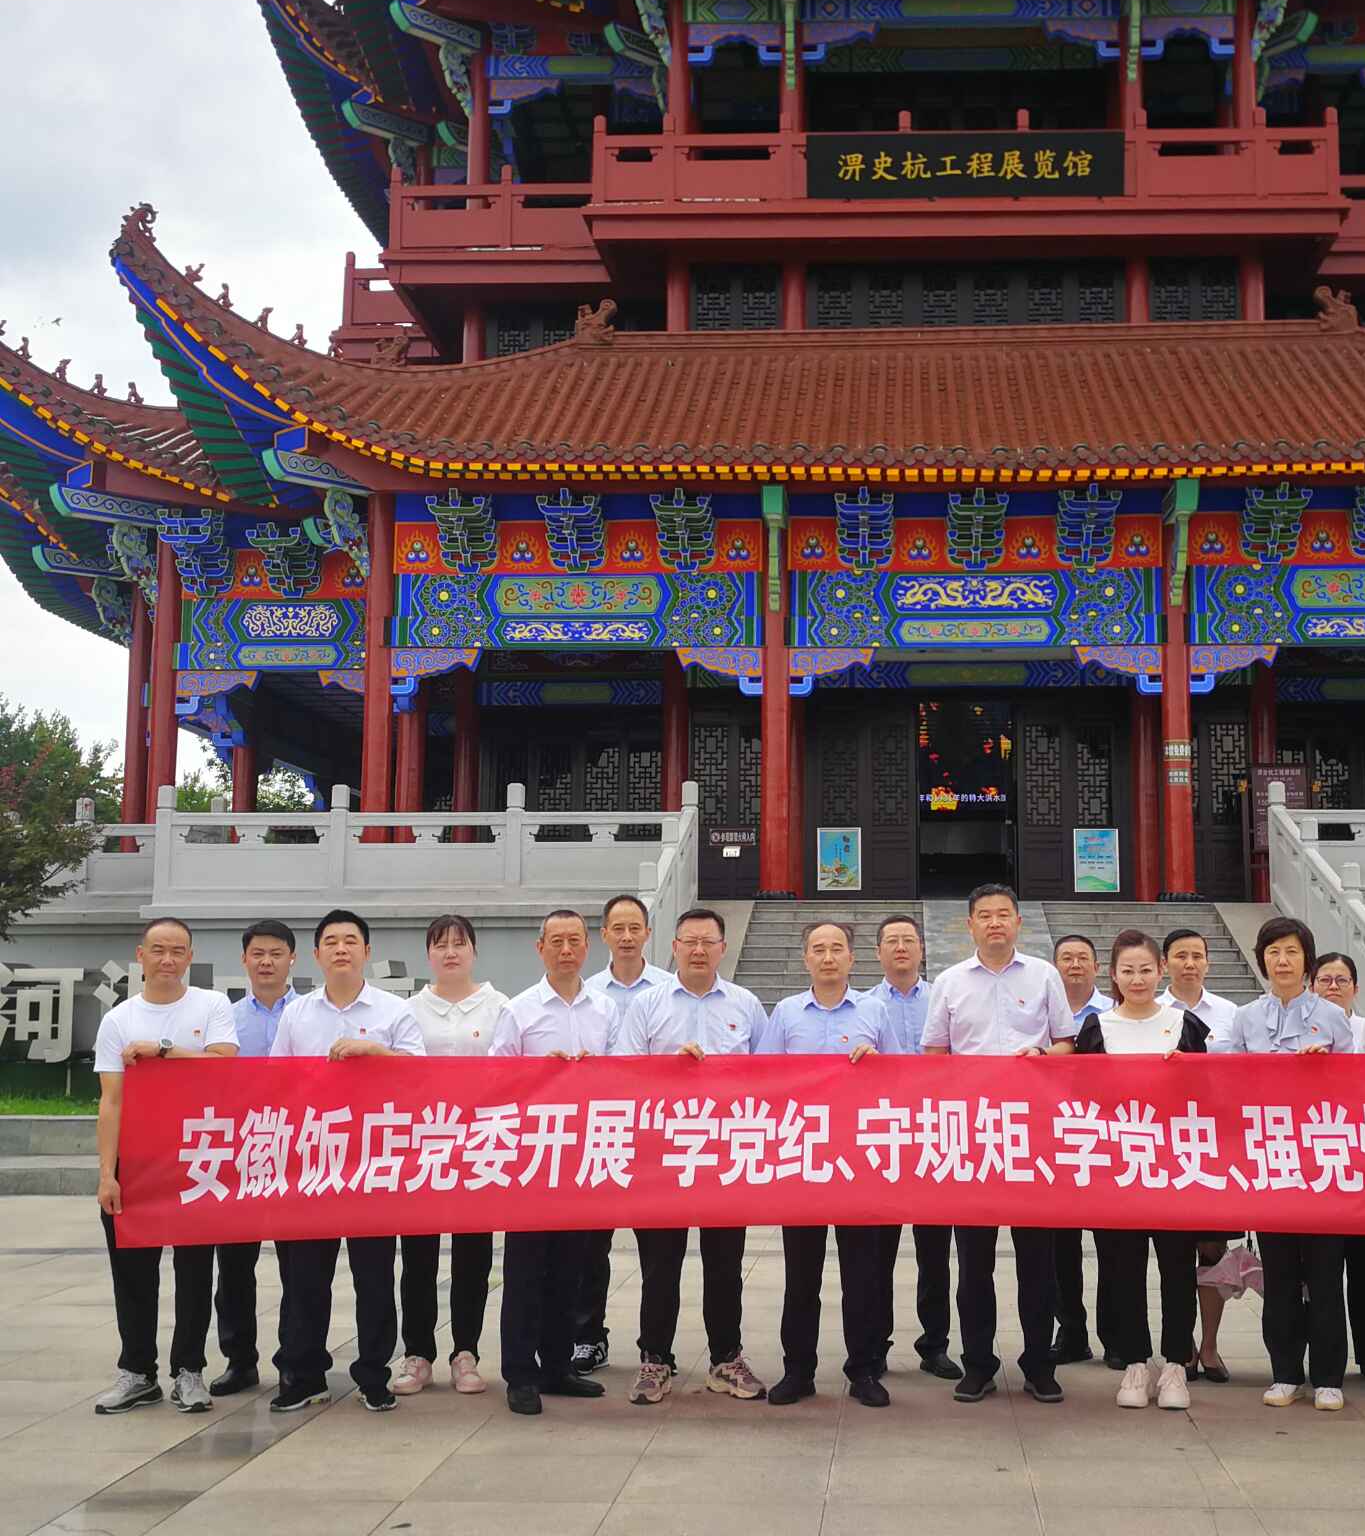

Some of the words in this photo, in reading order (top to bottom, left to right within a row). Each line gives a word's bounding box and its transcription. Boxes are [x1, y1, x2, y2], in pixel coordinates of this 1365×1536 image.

[837, 149, 1094, 181] 淠史杭工程展览馆
